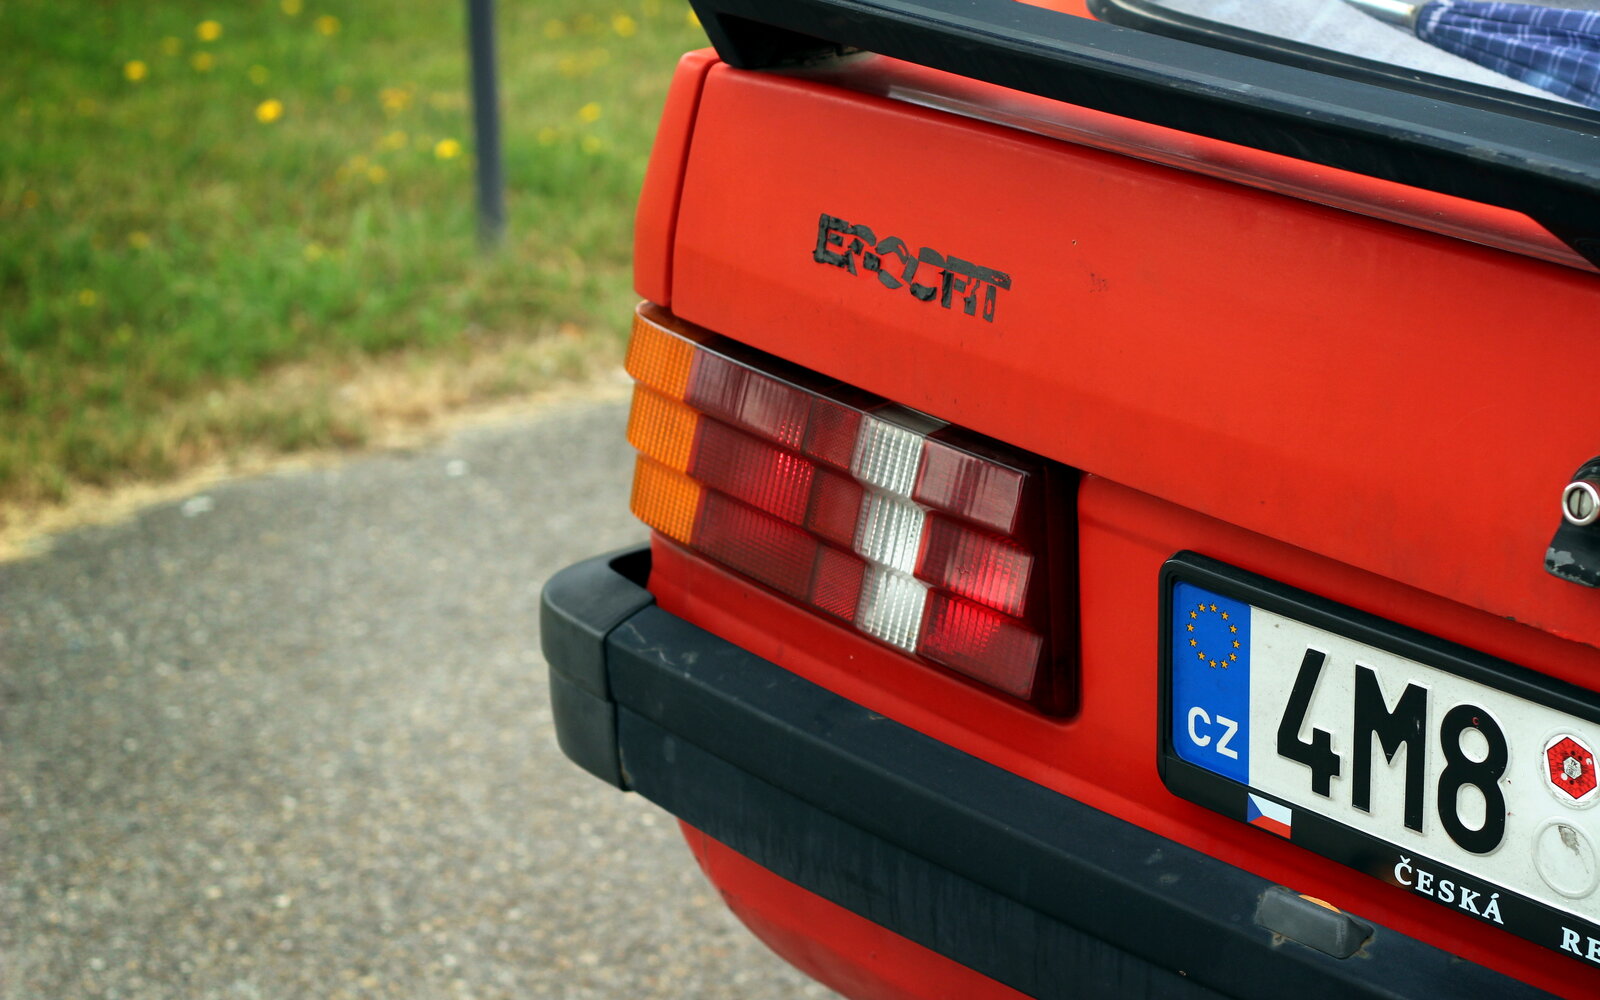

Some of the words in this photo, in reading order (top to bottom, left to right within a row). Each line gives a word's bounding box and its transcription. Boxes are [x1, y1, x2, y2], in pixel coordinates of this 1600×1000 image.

[1188, 706, 1238, 760] CZ
[1277, 648, 1508, 855] 4M8
[1394, 855, 1504, 925] ČESKÁ
